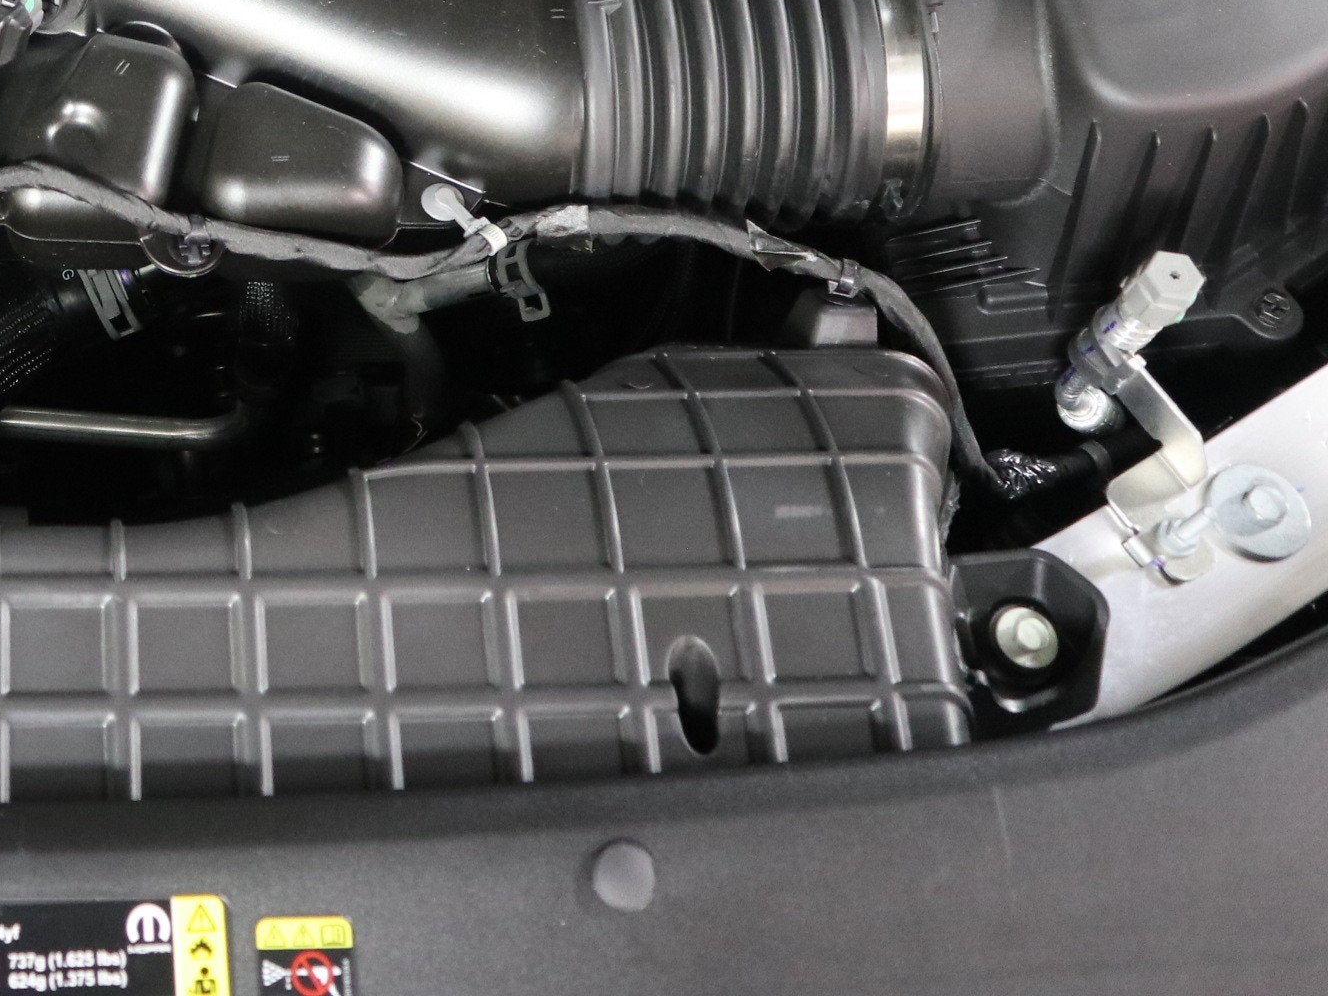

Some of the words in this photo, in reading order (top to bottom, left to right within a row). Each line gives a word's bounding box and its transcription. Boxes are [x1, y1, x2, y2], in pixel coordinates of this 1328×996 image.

[7, 952, 47, 973] 737g
[48, 950, 96, 972] (1.625
[96, 948, 128, 970] lbs)
[48, 969, 96, 991] (1.375
[96, 967, 128, 989] lbs)
